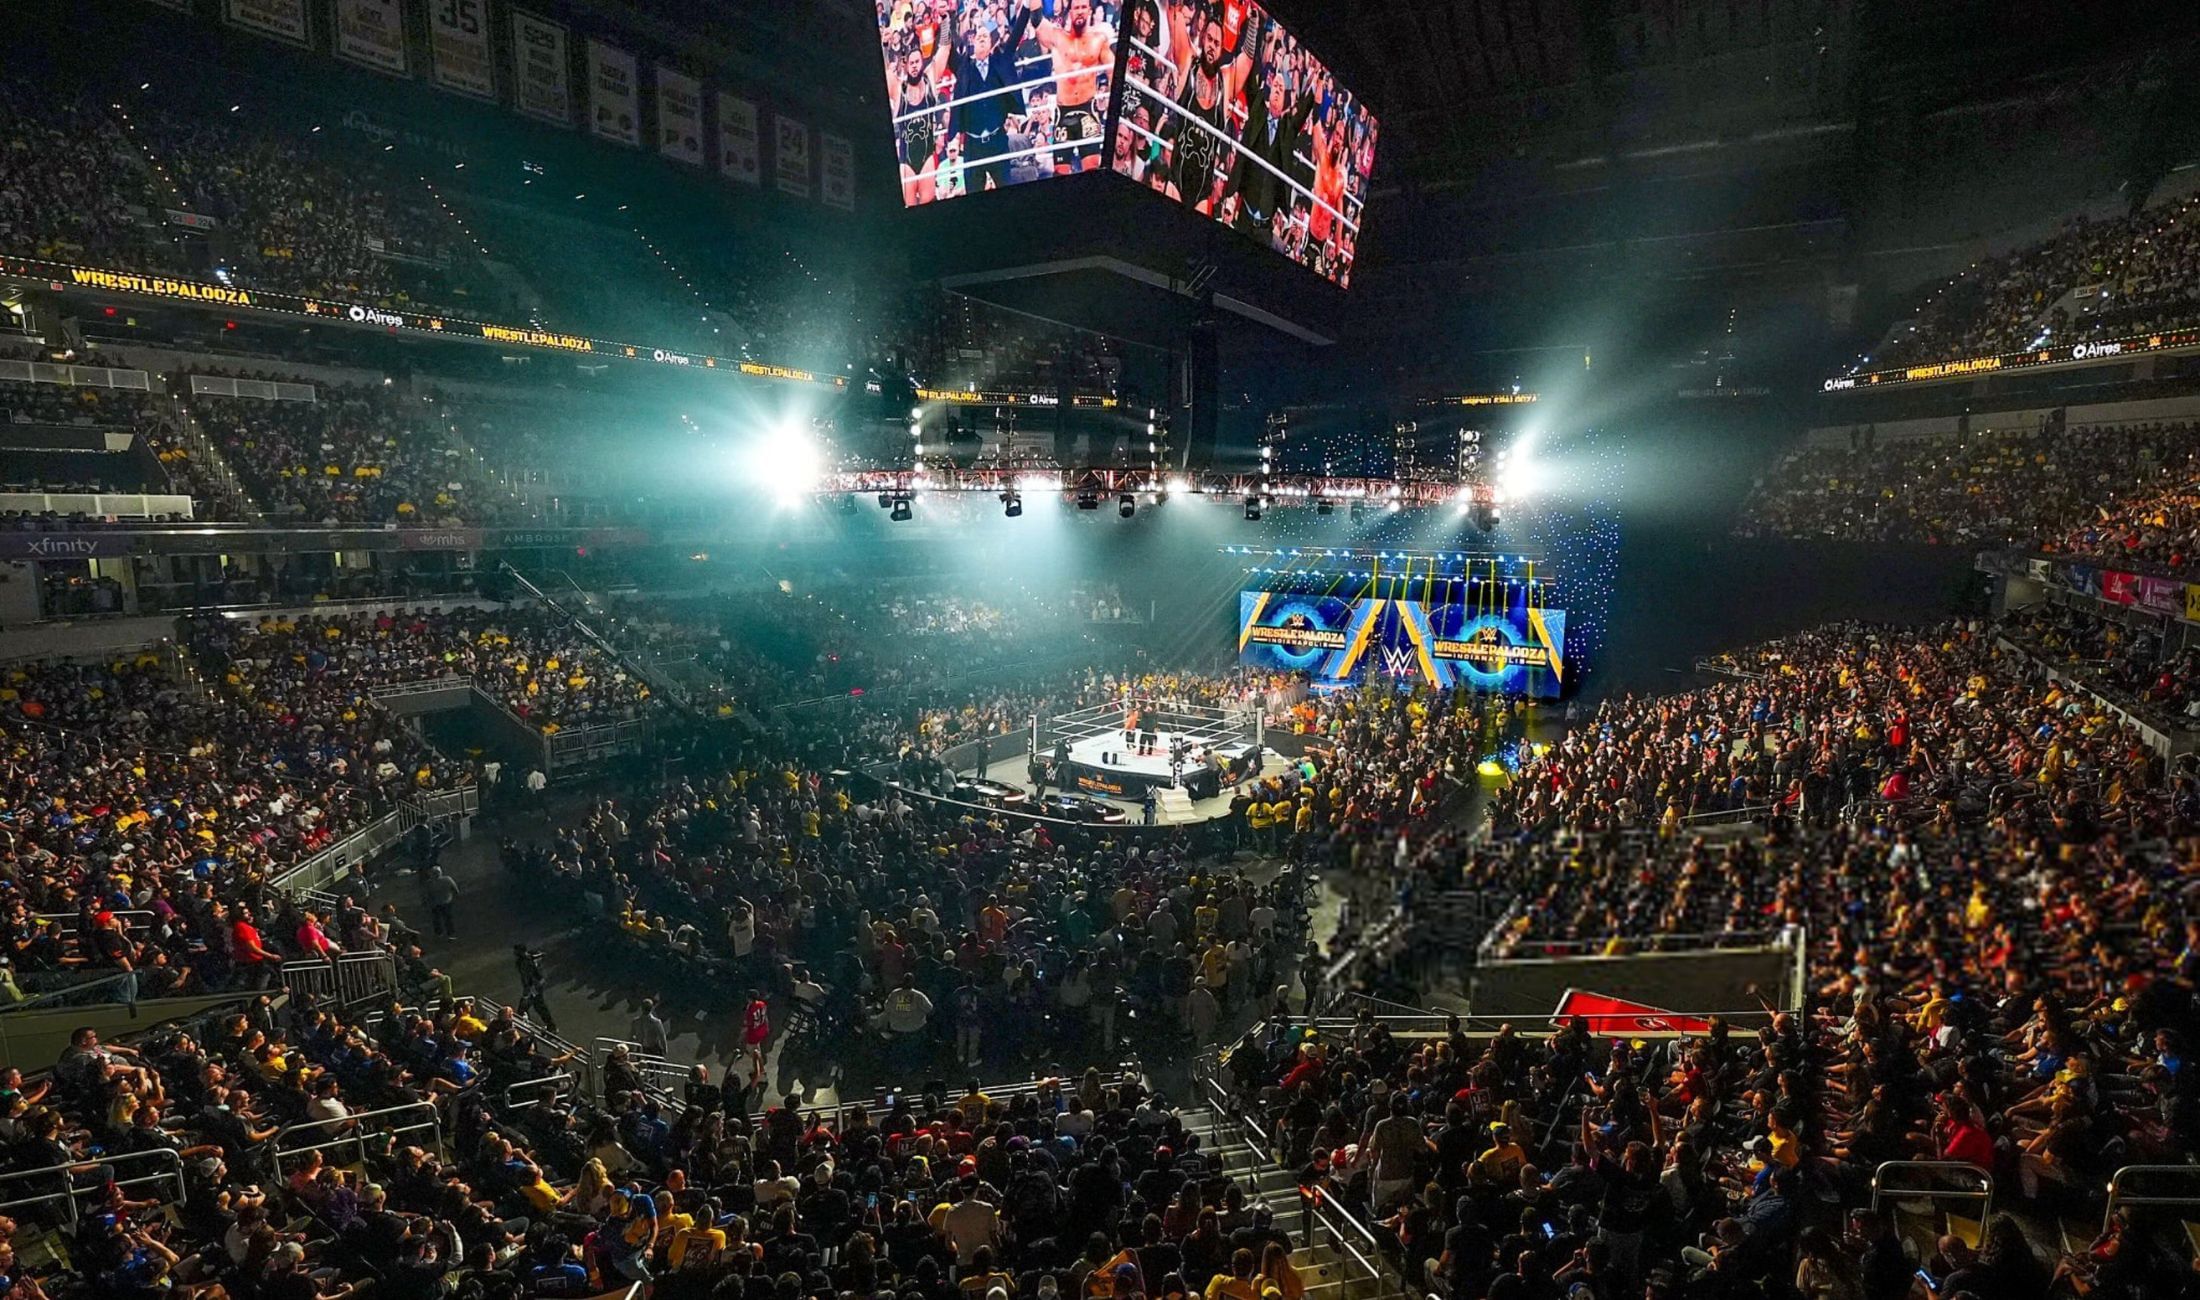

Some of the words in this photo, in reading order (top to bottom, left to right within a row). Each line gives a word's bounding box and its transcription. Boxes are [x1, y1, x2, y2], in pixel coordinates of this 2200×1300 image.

[71, 268, 251, 305] WRESTLEPALOOZA
[365, 309, 404, 326] Aires
[482, 326, 592, 351] WRESTLEPALOOZA
[2085, 342, 2121, 356] Aires
[1906, 357, 2001, 379] WRESTLEPALOOZA
[28, 537, 98, 555] xfinity
[437, 534, 465, 545] mhs
[1252, 626, 1346, 643] WRESTLEPALOOZA
[1433, 640, 1546, 660] WRESTLEPALOOZA
